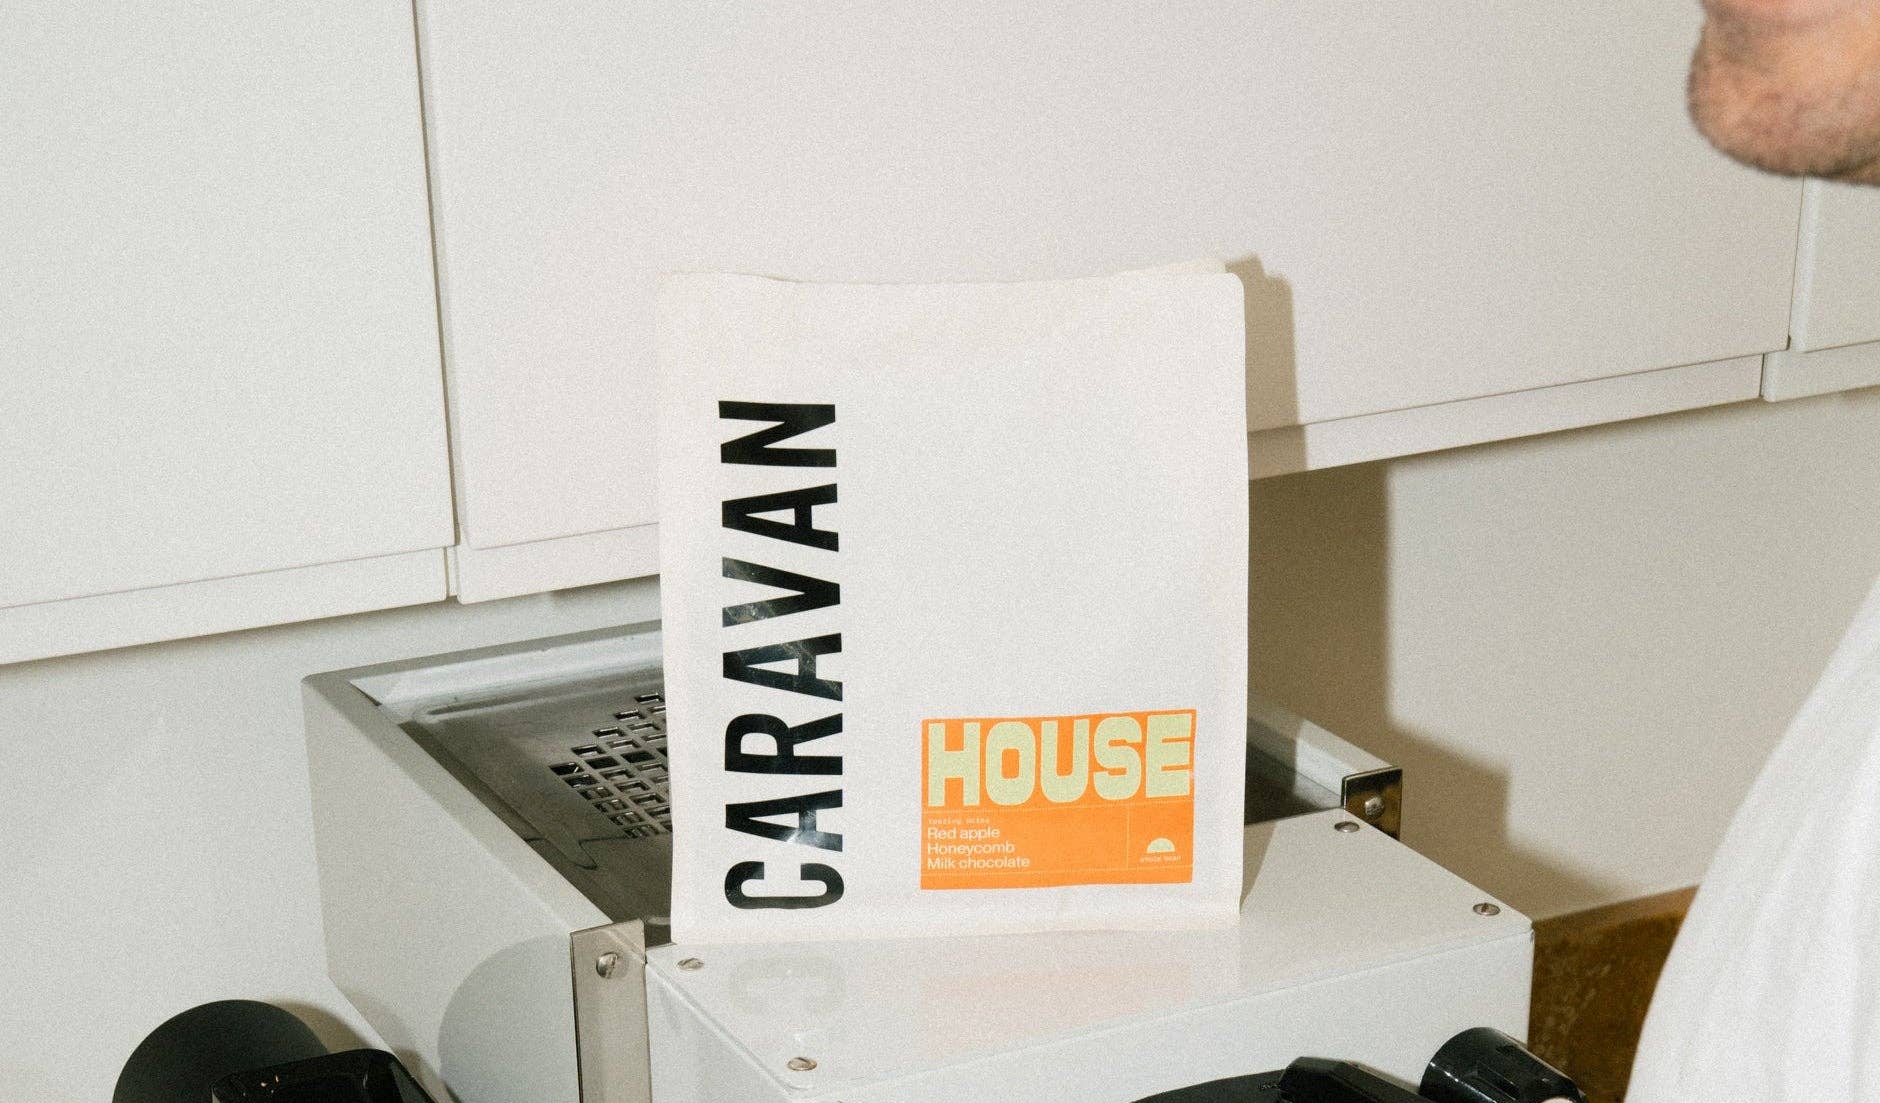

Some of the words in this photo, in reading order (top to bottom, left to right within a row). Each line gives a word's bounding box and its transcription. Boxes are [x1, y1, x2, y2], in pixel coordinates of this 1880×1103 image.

[718, 400, 844, 910] CARAVAN
[928, 713, 1193, 807] HOUSE
[927, 827, 957, 839] Red
[960, 826, 1001, 841] apple
[927, 841, 1016, 856] Honeycomb
[927, 857, 956, 870] Milk
[959, 856, 1031, 869] chocolate
